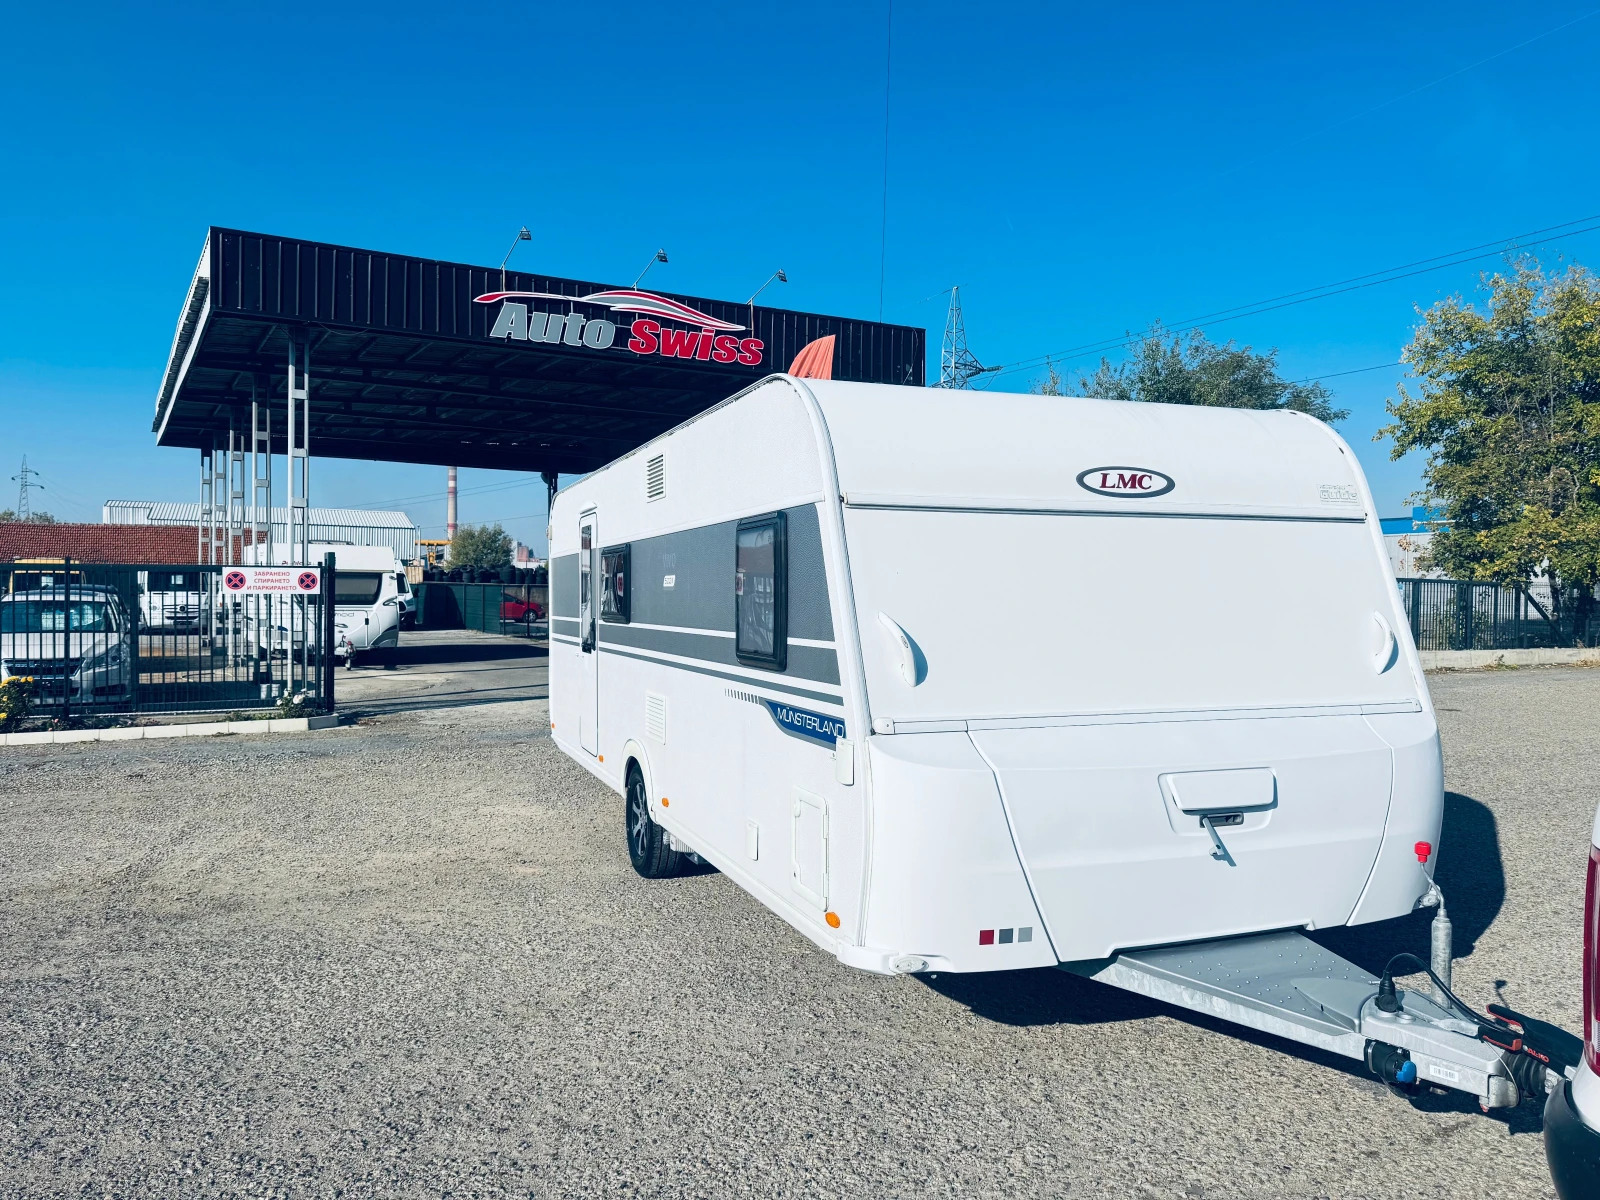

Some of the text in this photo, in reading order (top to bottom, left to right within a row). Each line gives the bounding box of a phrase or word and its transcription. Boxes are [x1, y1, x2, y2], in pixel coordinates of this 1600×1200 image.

[490, 302, 764, 365] Auto Swiss
[1099, 472, 1152, 490] LMC
[776, 706, 845, 738] MÜNSTERLAND
